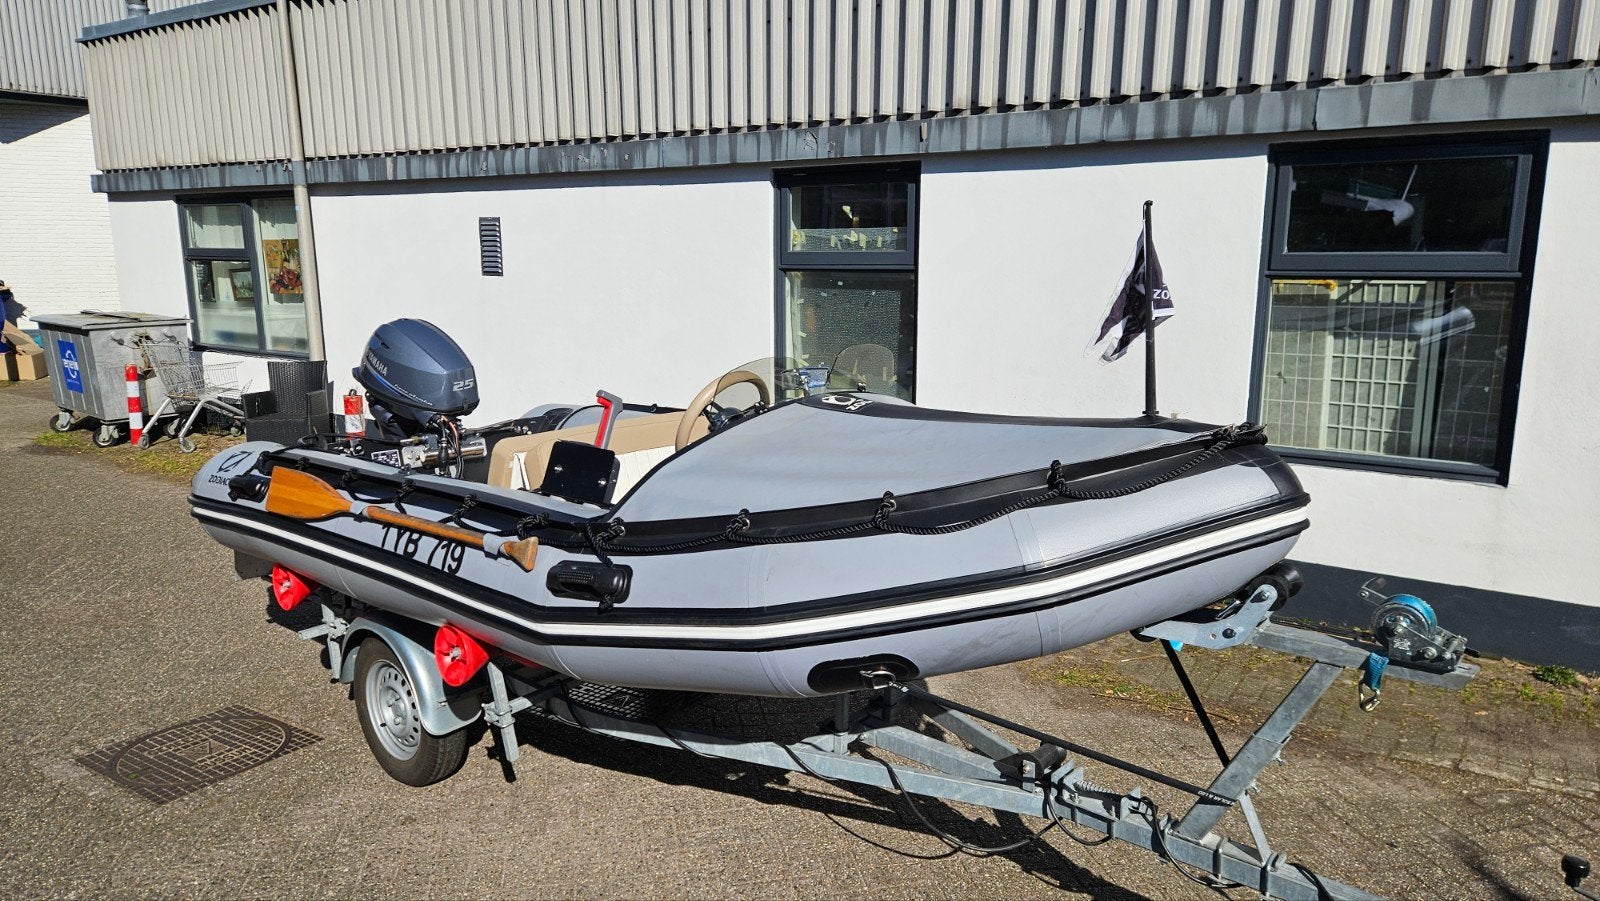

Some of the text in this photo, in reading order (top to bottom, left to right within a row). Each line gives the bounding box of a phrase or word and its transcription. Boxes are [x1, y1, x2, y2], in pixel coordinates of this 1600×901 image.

[367, 352, 388, 376] YAMAHA
[452, 379, 475, 392] 25
[427, 537, 466, 575] 719
